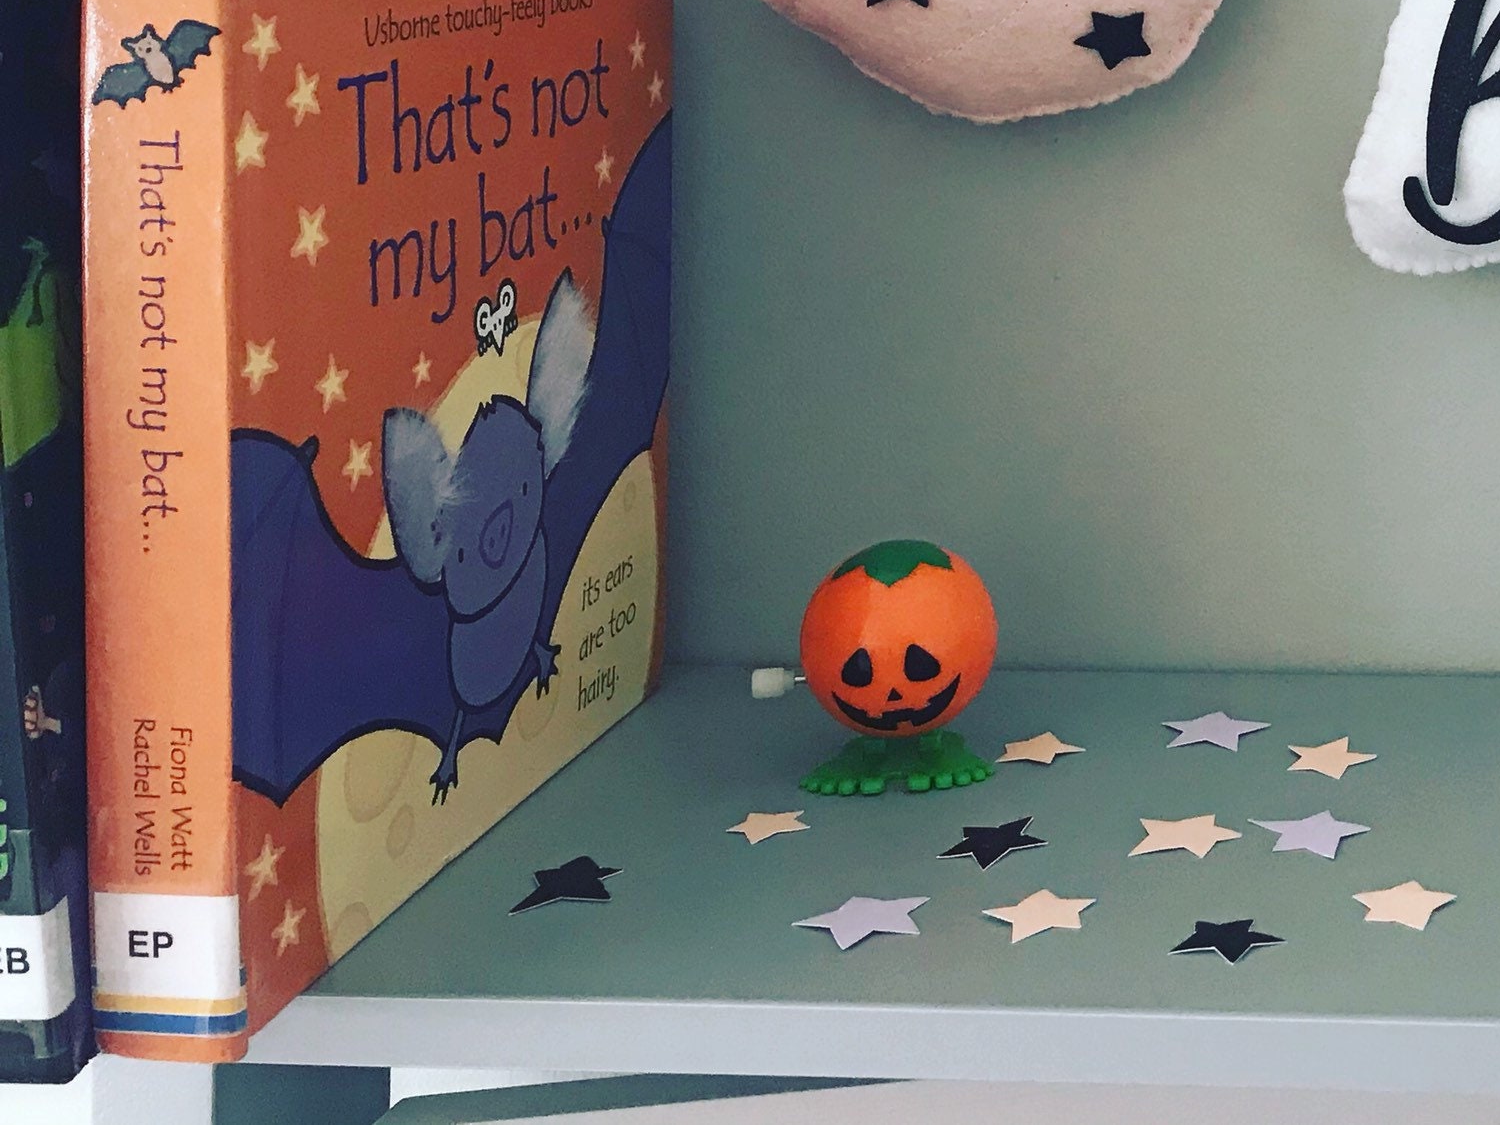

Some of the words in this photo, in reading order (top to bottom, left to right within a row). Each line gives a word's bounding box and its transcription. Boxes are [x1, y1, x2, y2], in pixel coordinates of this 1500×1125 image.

[364, 8, 440, 47] Usborne
[337, 59, 511, 185] That's
[531, 38, 610, 138] not
[138, 130, 184, 257] That's
[368, 218, 457, 324] my
[478, 165, 592, 276] bat...
[138, 276, 178, 350] not
[126, 367, 168, 431] my
[140, 448, 184, 553] bat...
[582, 577, 600, 611] its
[605, 555, 633, 592] ears
[579, 625, 604, 661] are
[609, 602, 637, 638] too
[578, 665, 619, 711] hairy.
[133, 718, 161, 799] Rachel
[170, 726, 193, 795] Fiona
[134, 809, 161, 876] Wells
[171, 806, 193, 871] Watt
[0, 947, 30, 974] B
[128, 930, 173, 958] EP
